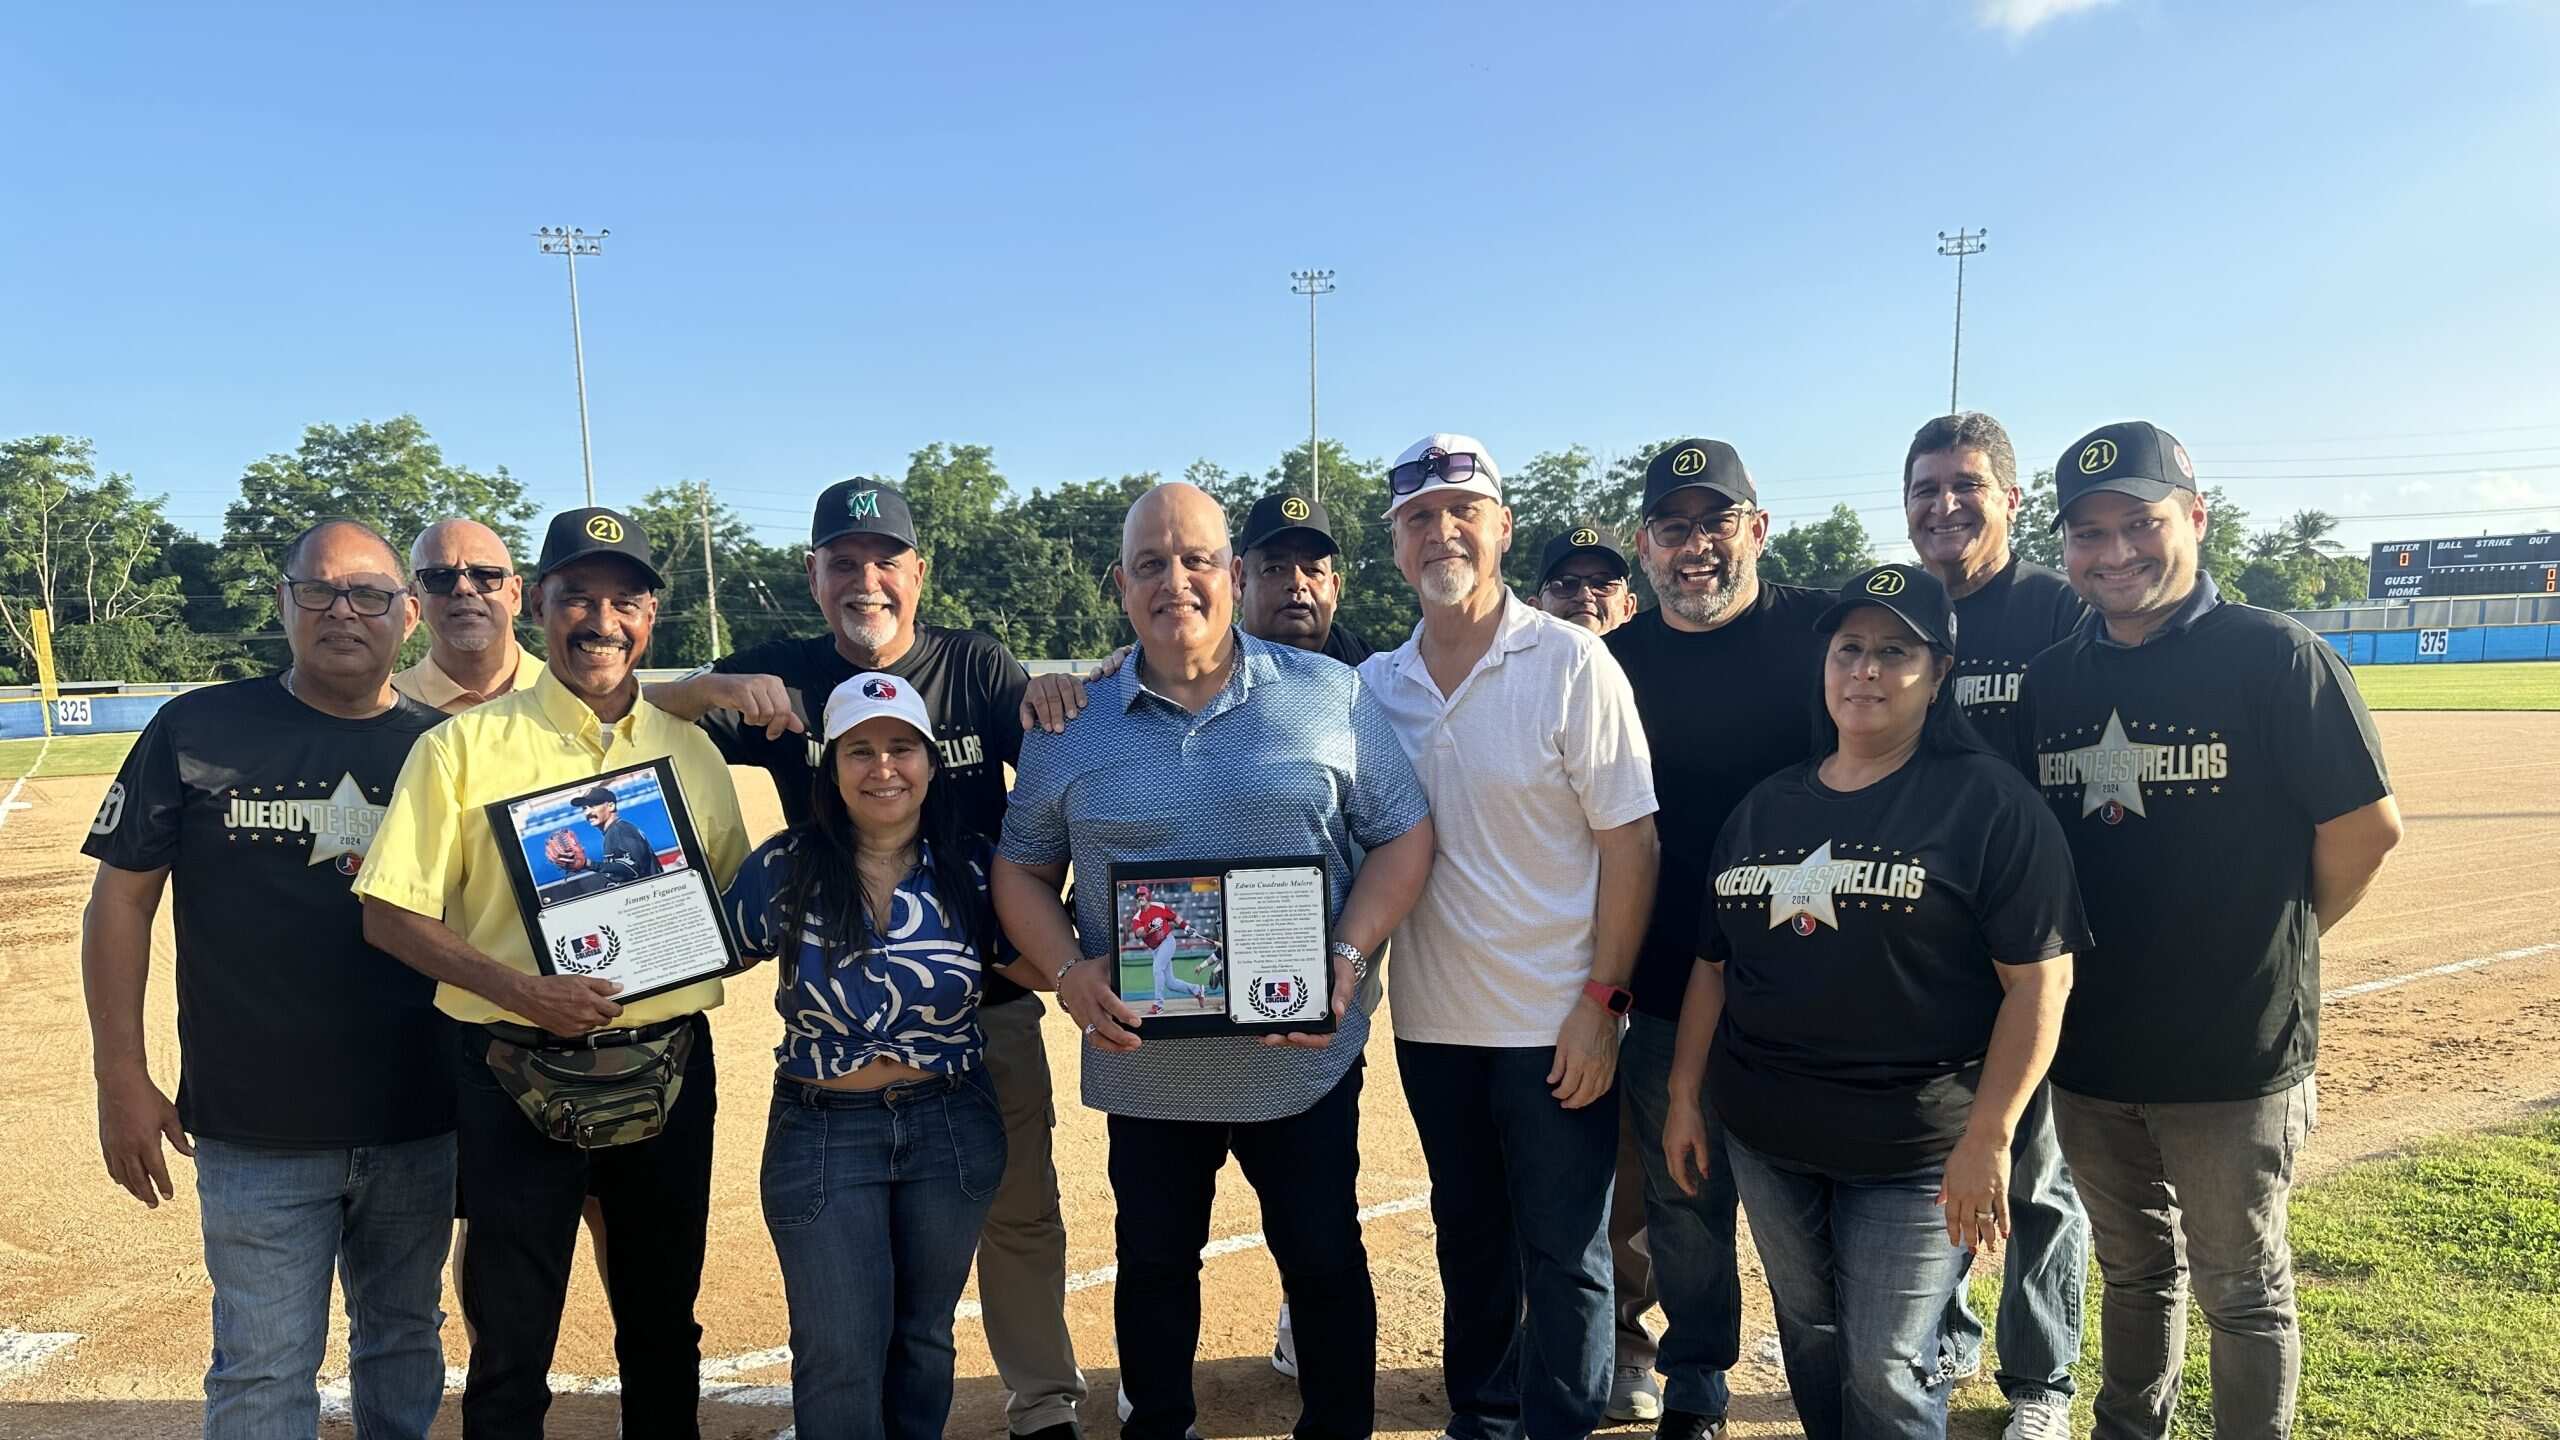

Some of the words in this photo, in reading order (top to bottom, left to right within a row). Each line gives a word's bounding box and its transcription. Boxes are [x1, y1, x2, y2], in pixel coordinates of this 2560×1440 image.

[1678, 454, 1700, 472] 21
[2085, 445, 2110, 469] 21
[1287, 501, 1305, 516] 21
[594, 520, 618, 539] 21
[1577, 531, 1594, 544] 21
[2382, 543, 2420, 553] BATTER
[2436, 541, 2463, 550] BALL
[2475, 538, 2515, 548] STRIKE
[2529, 536, 2552, 545] OUT
[2400, 552, 2409, 567] 0
[2384, 575, 2423, 585] GUEST
[2547, 568, 2556, 580] 0
[1871, 575, 1899, 591] 21
[2546, 580, 2556, 592] 0
[2387, 587, 2423, 597] HOME
[2421, 631, 2447, 652] 375
[60, 700, 88, 722] 325
[935, 735, 985, 769] ELLAS
[2081, 752, 2105, 785] DE
[2107, 742, 2228, 784] ESTRELLAS
[2102, 783, 2120, 794] 2024
[223, 798, 304, 832] JUEGO
[308, 804, 339, 835] DE
[339, 836, 361, 846] 2024
[1257, 881, 1289, 889] Cuadrado
[1768, 867, 1802, 896] DE
[1800, 861, 1927, 900] ESTRELLAS
[624, 893, 651, 906] Jimmy
[652, 883, 688, 899] Figueroa
[1791, 895, 1811, 905] 2024
